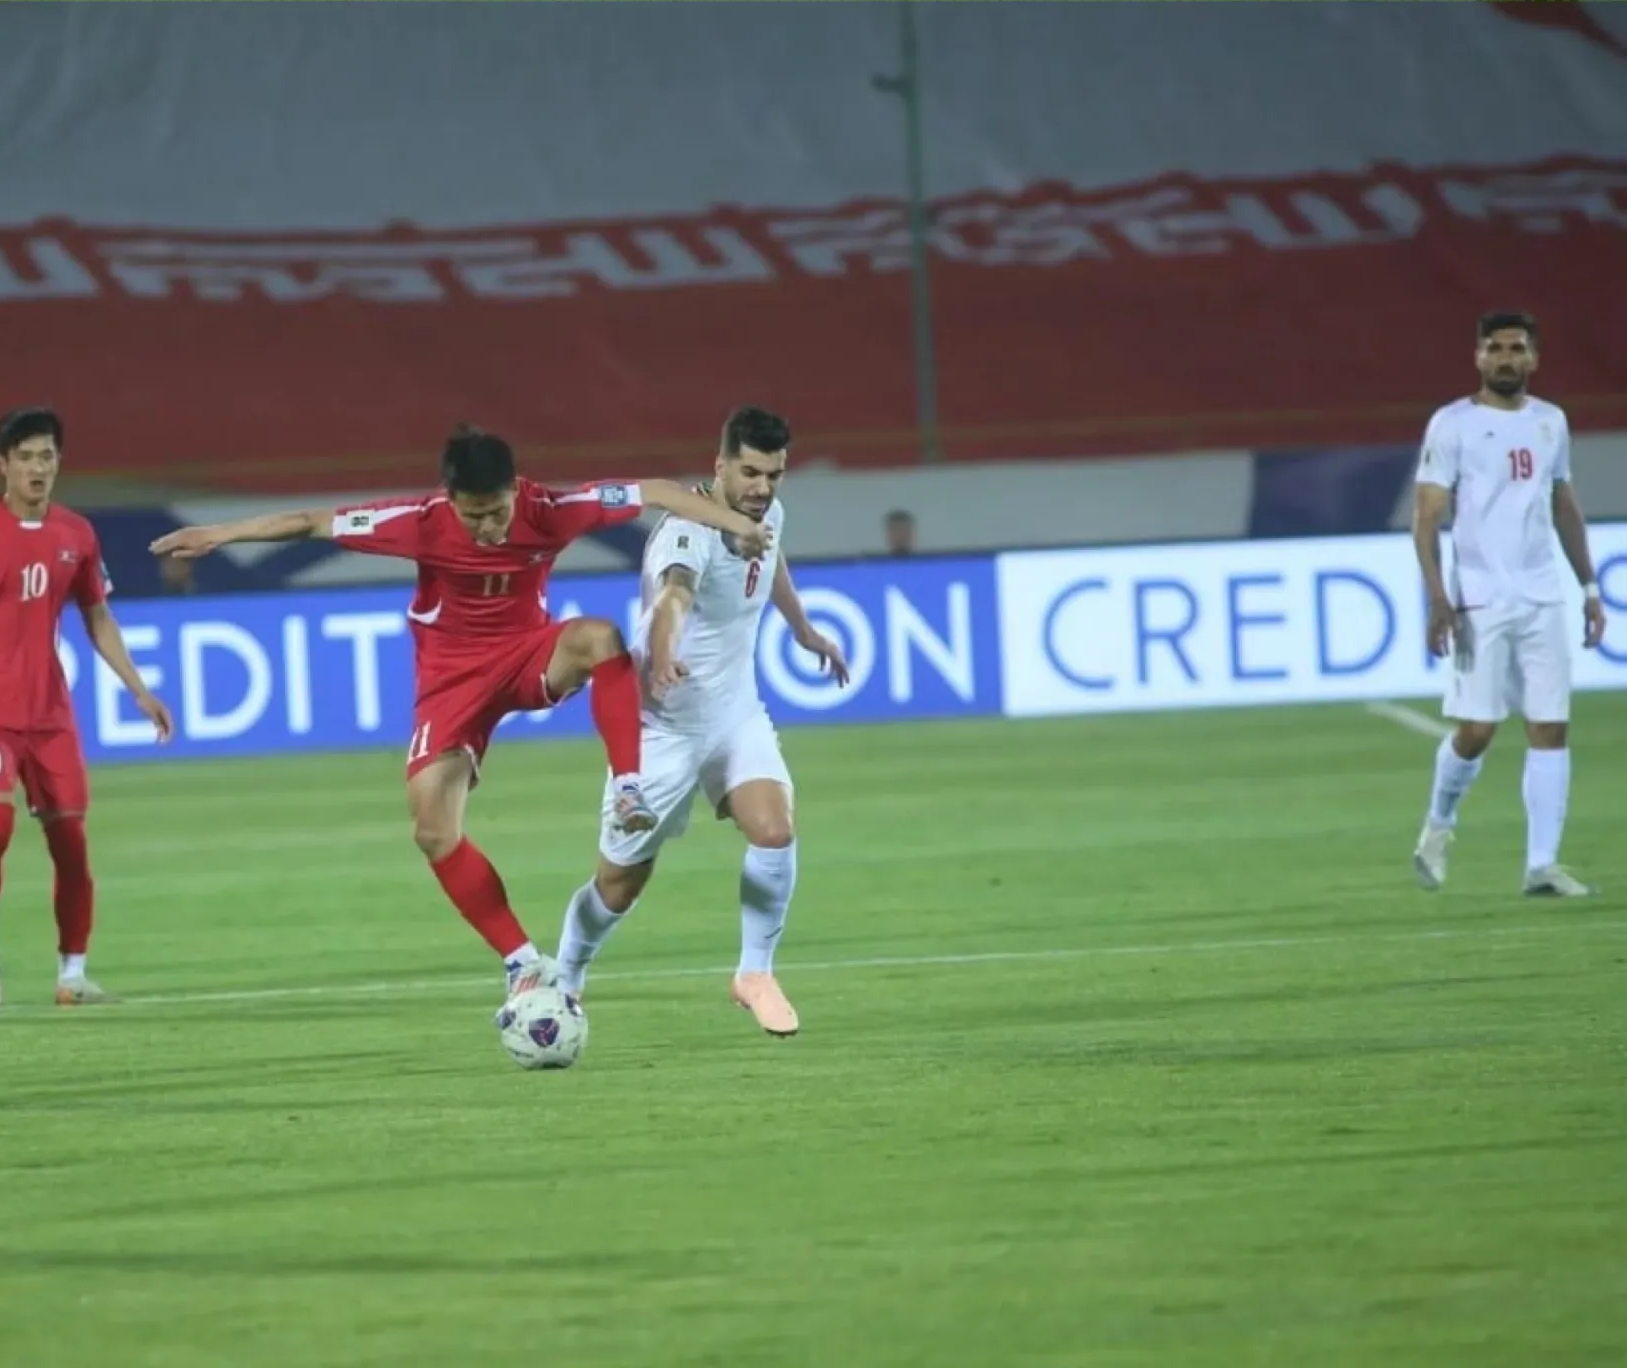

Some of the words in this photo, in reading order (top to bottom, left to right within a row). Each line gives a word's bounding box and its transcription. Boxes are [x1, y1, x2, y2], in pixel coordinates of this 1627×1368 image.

[1507, 447, 1535, 482] 19
[19, 562, 50, 602] 10
[482, 572, 510, 597] 11
[744, 558, 761, 600] 6
[1043, 568, 1439, 690] CRED
